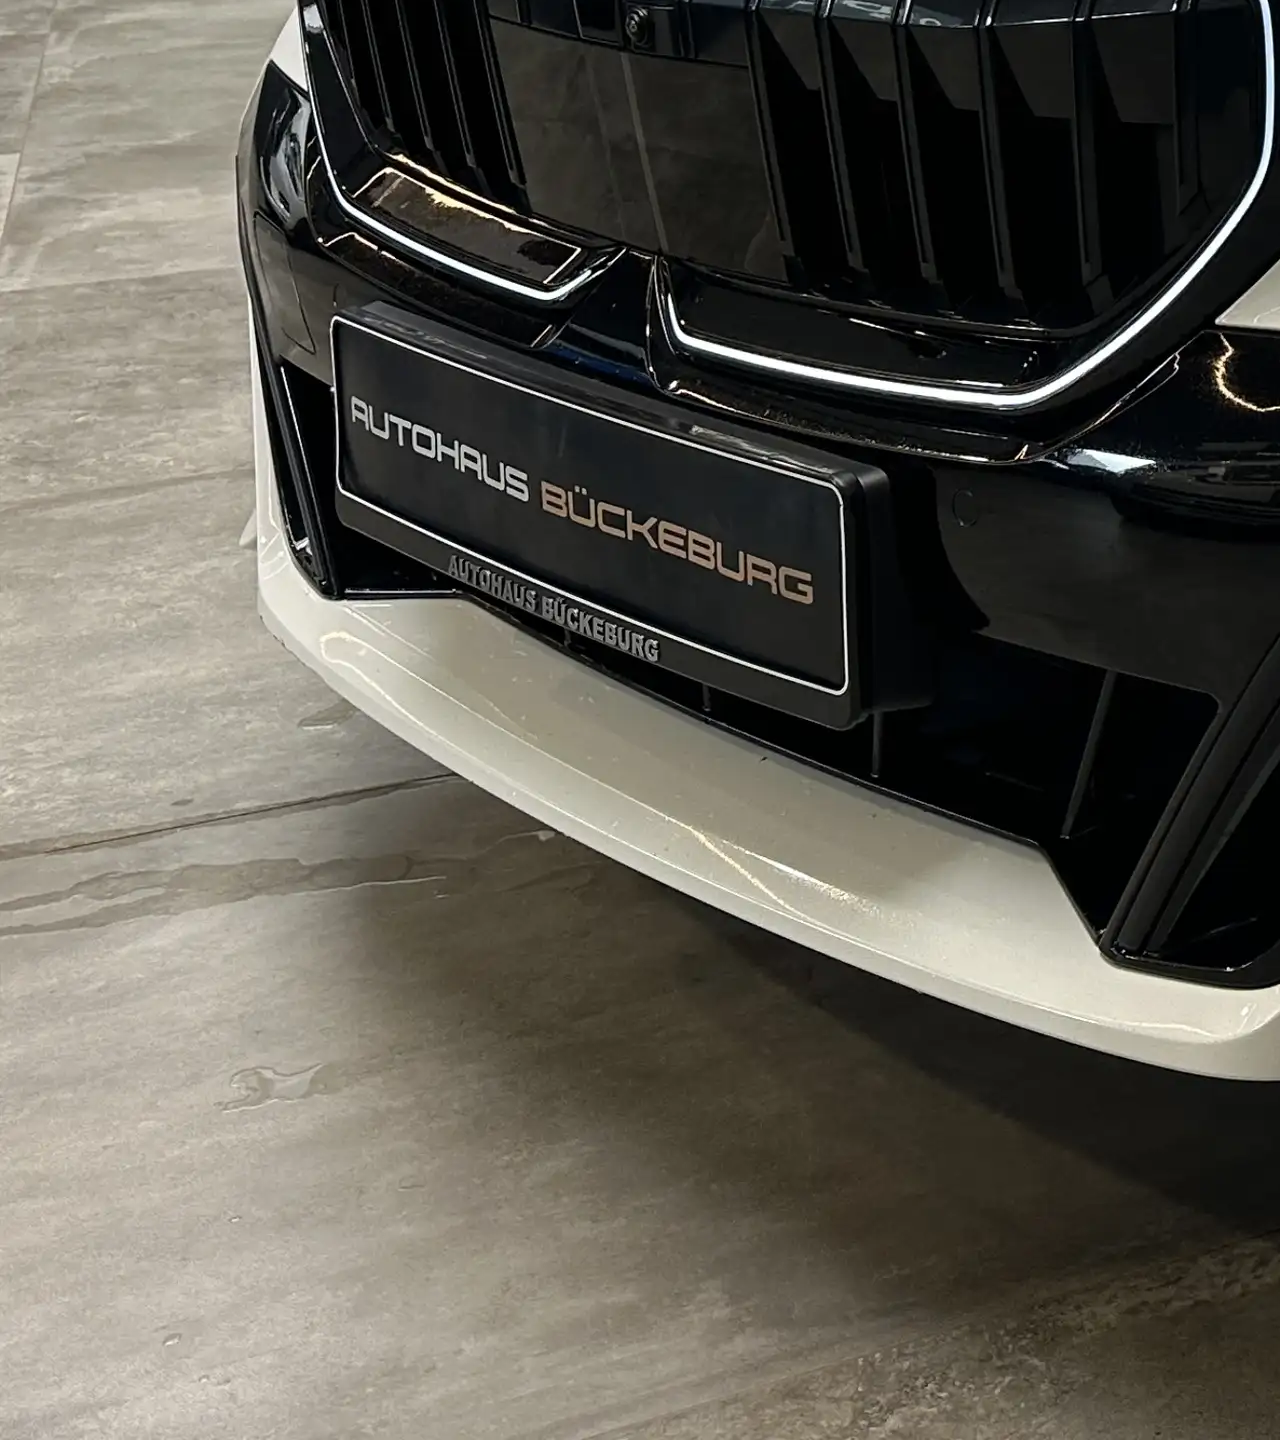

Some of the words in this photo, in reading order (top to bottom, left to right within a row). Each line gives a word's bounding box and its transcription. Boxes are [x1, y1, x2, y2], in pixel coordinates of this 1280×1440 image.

[350, 395, 530, 502] AUTOHAUS
[540, 480, 814, 605] BÜCKEBURG
[449, 555, 538, 612] AUTOHAUS
[542, 596, 659, 662] BÜCKEBURG
